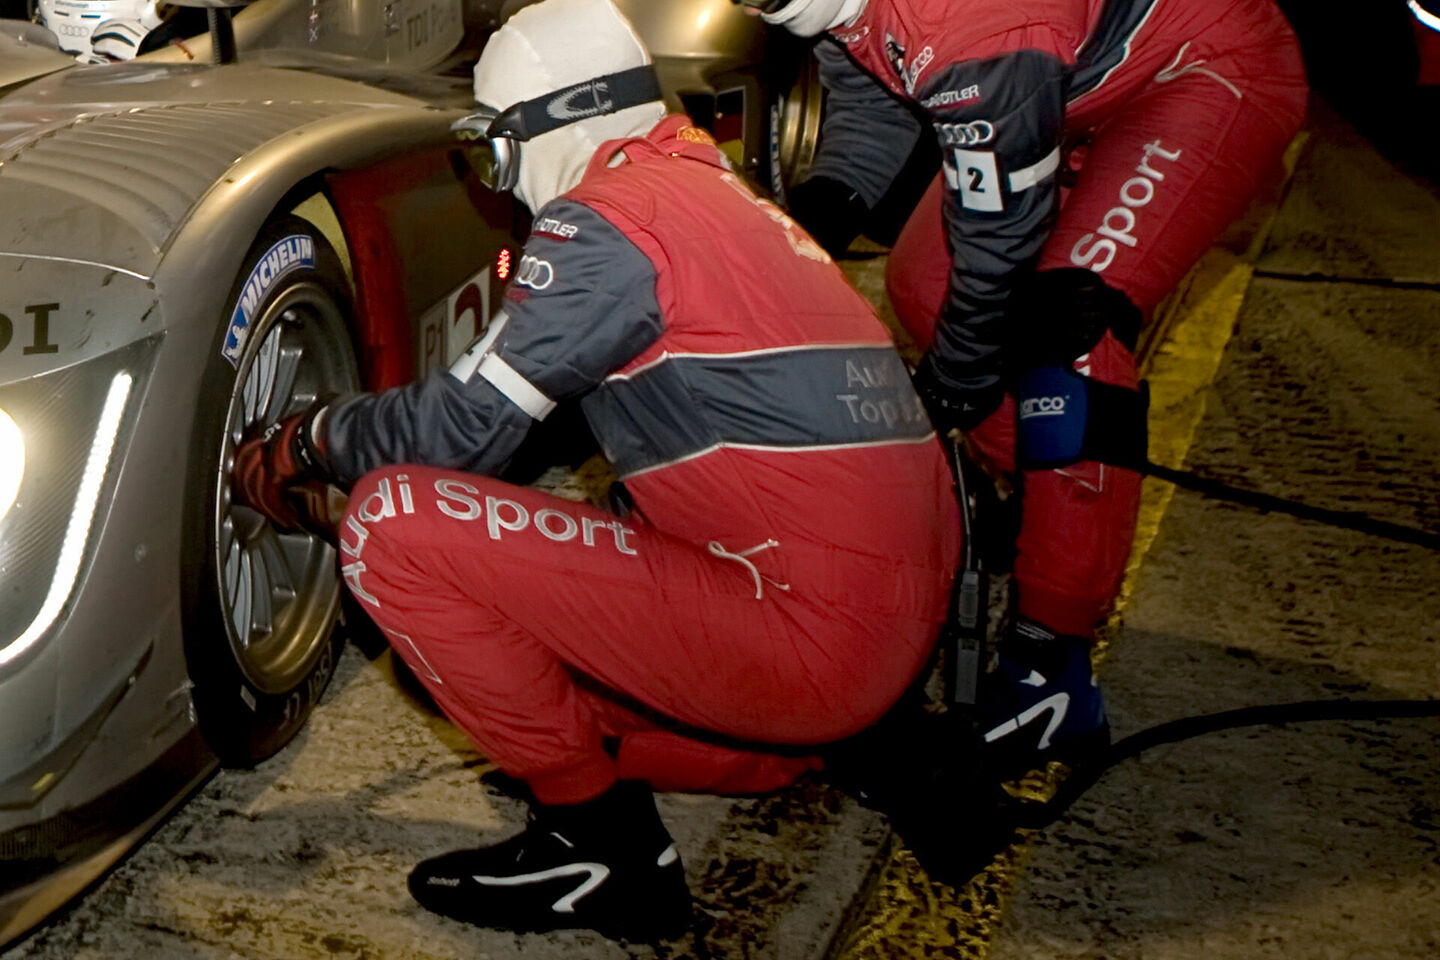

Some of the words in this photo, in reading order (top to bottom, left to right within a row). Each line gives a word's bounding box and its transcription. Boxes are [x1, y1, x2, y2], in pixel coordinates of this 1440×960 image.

[967, 167, 985, 194] 2
[1070, 139, 1182, 273] Sport
[240, 238, 313, 325] MICHELIN
[1020, 396, 1066, 415] arco
[340, 474, 415, 608] Audi
[434, 478, 638, 556] Sport
